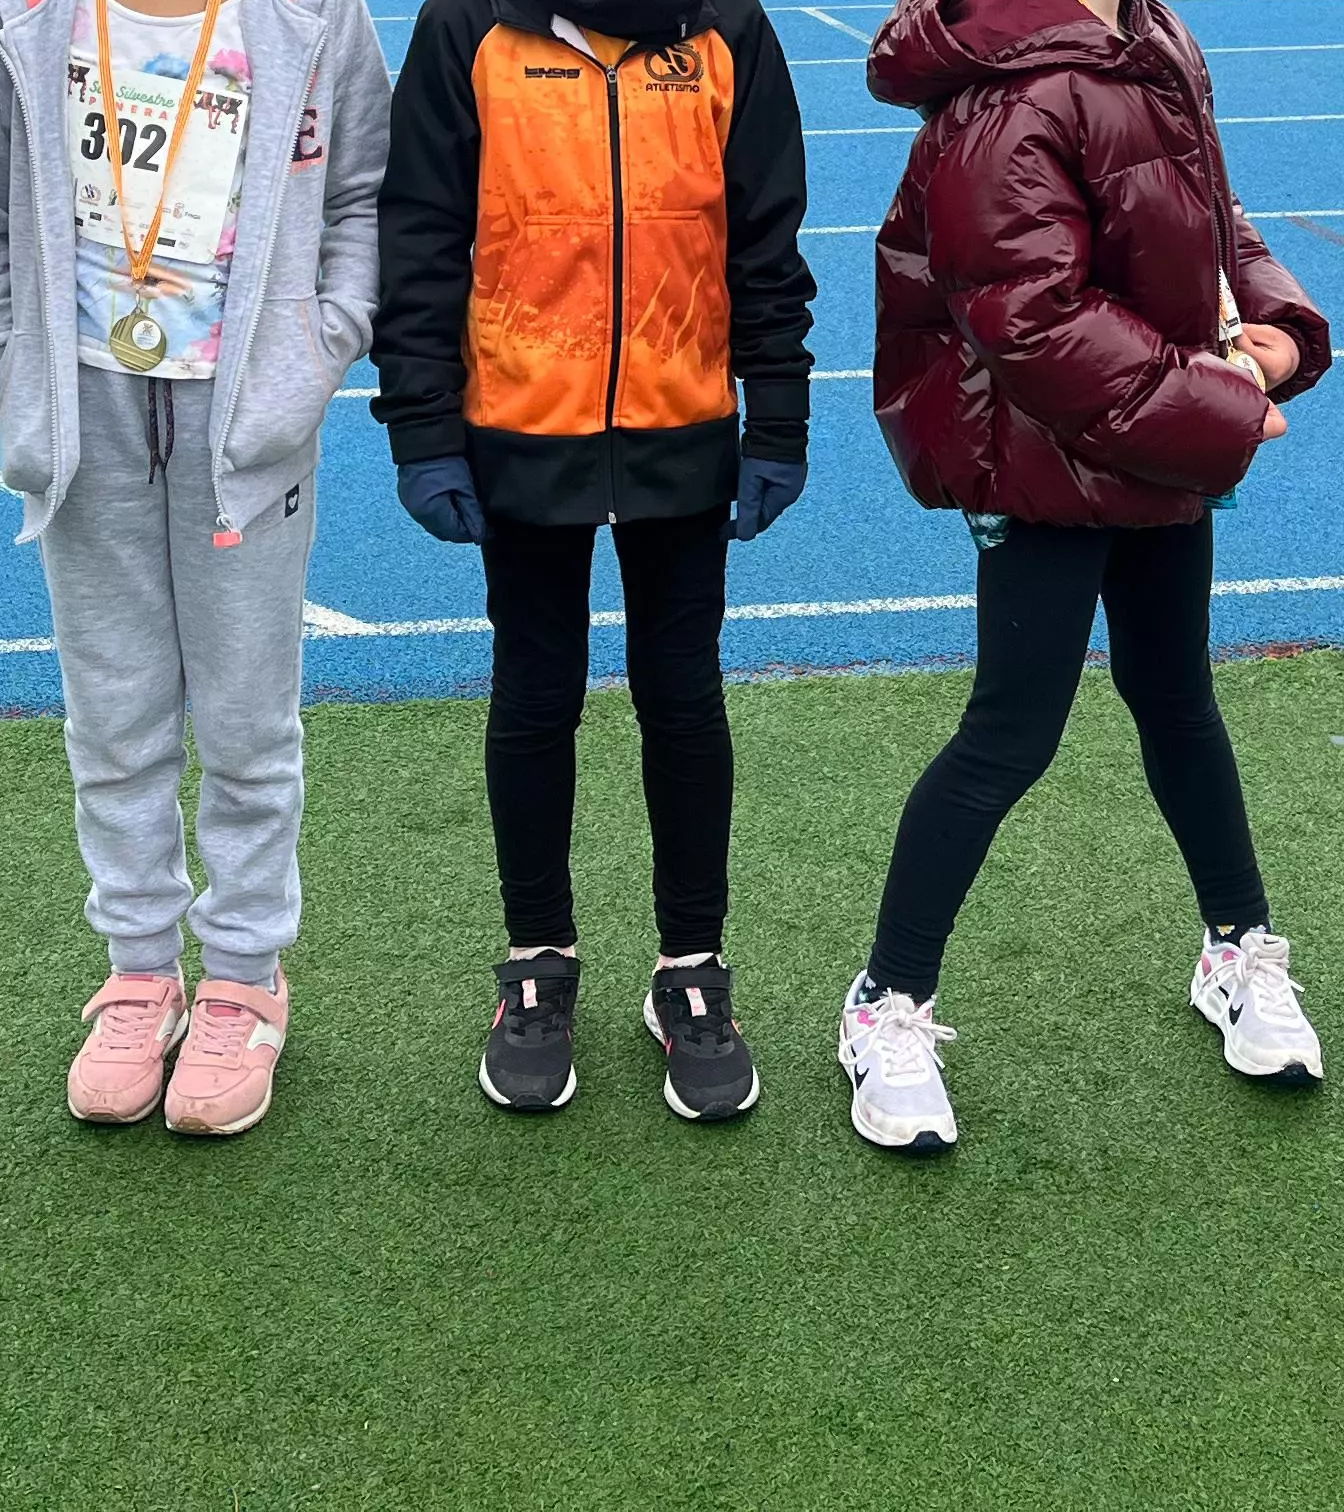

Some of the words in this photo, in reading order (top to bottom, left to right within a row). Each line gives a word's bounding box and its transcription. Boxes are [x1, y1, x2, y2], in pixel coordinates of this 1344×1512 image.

[116, 86, 176, 108] Silvestre
[645, 83, 700, 93] ATLETISMO
[81, 112, 167, 173] 302
